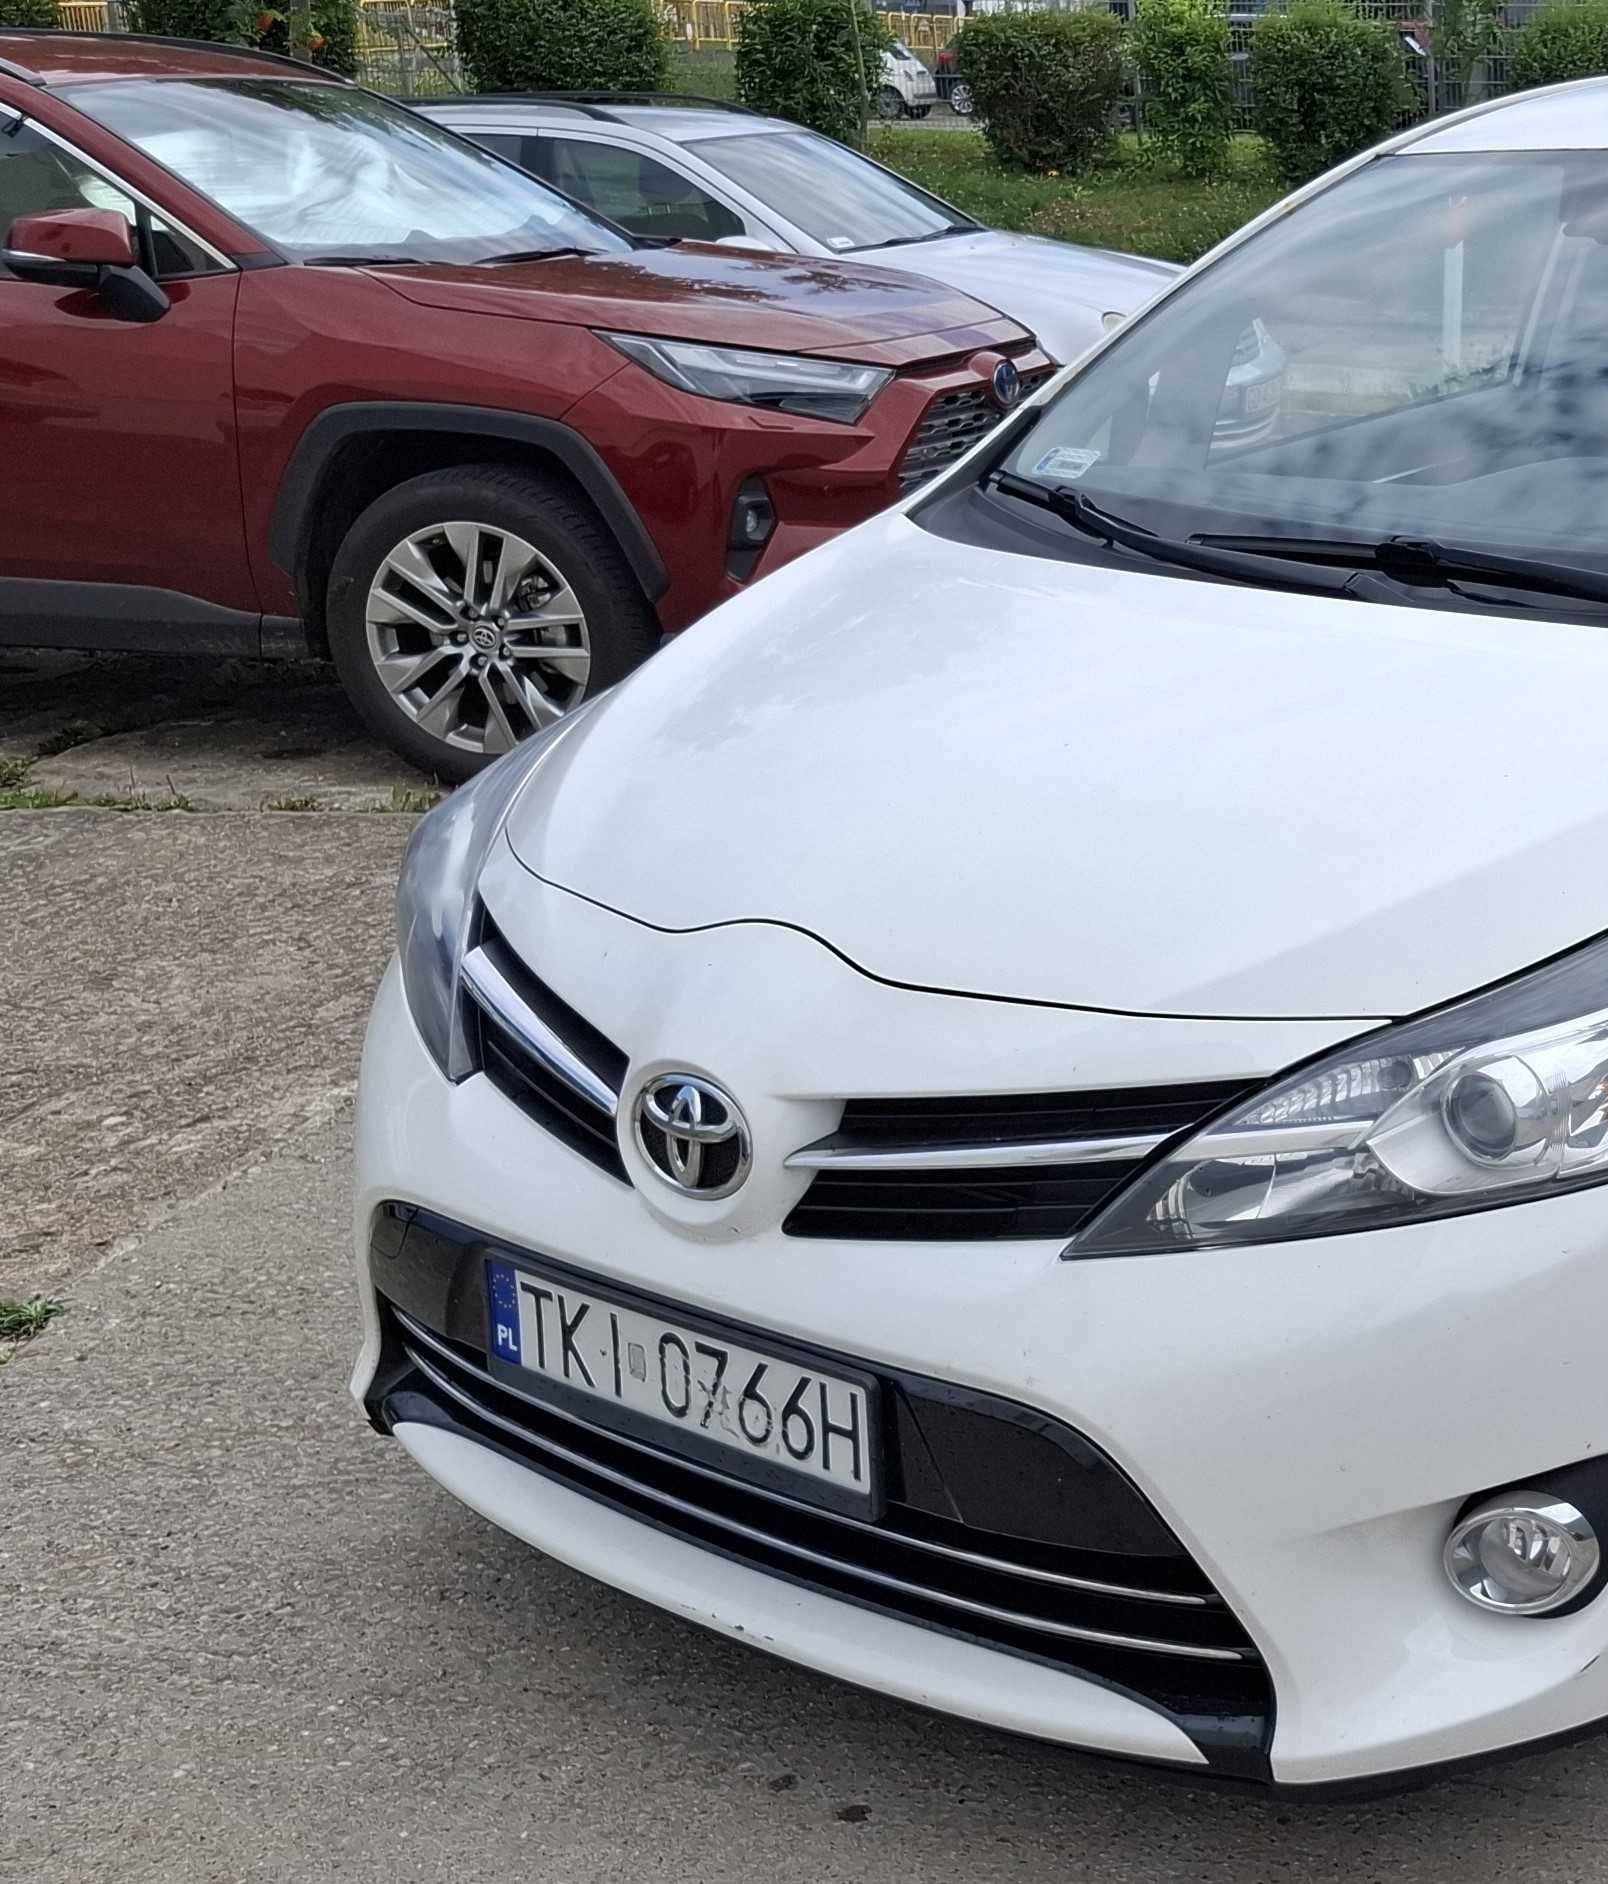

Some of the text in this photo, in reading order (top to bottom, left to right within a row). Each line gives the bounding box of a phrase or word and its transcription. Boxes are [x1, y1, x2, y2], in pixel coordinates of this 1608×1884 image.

[496, 1322, 519, 1352] PL
[520, 1280, 862, 1482] TKI 0766H
